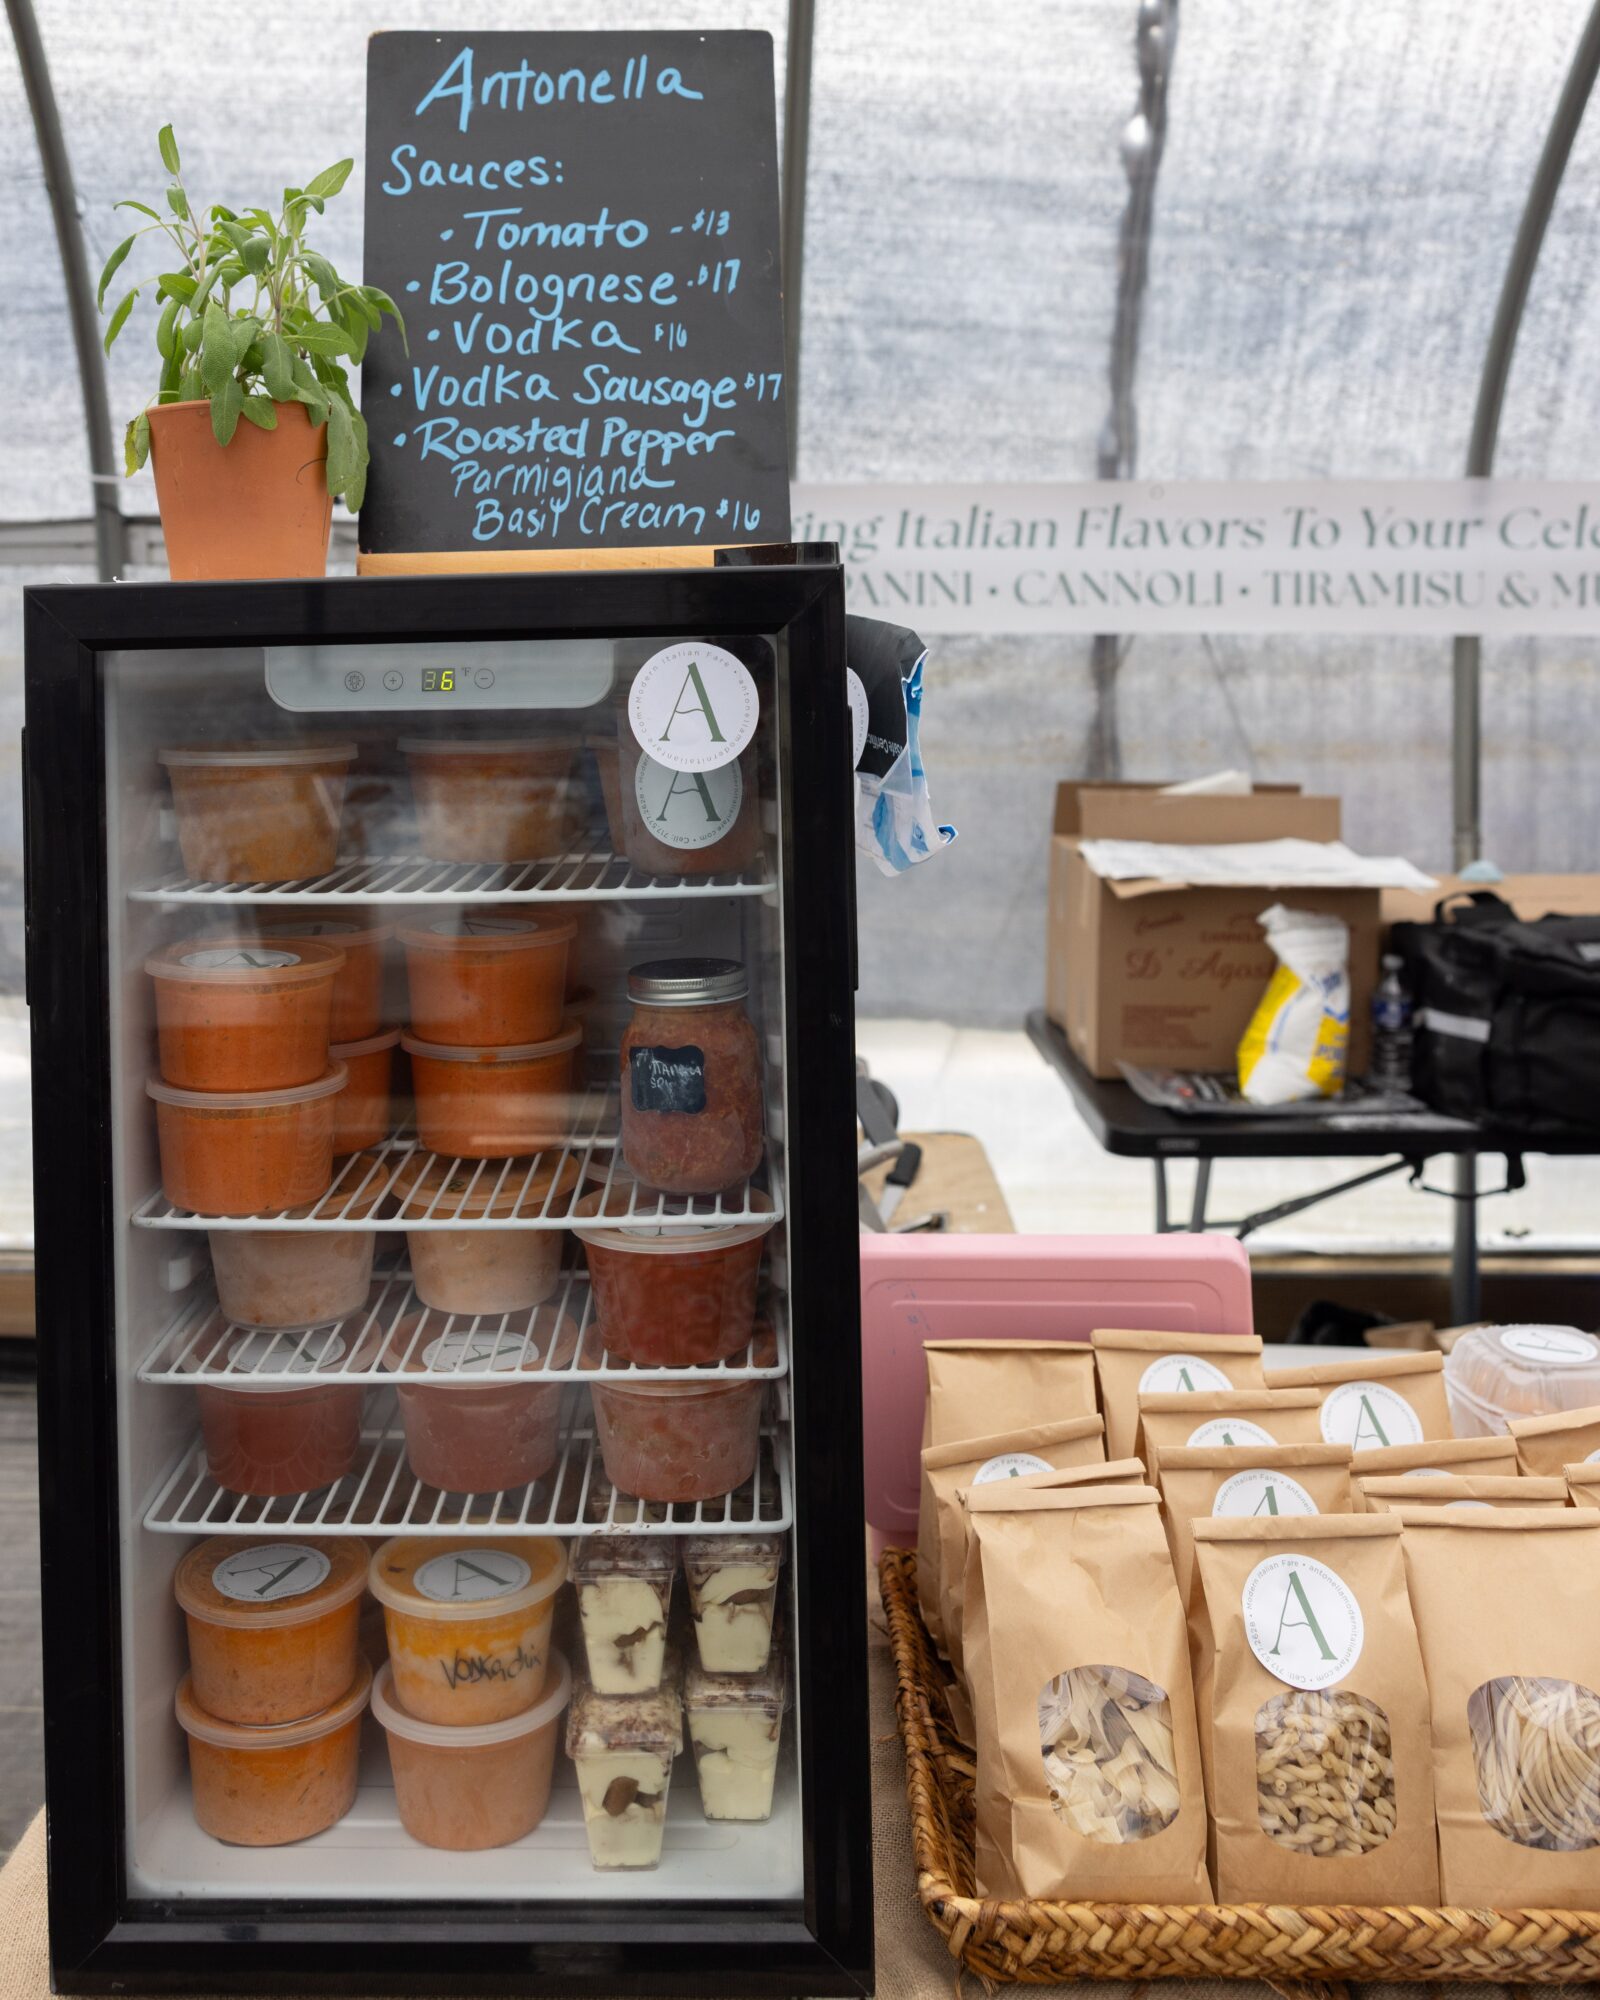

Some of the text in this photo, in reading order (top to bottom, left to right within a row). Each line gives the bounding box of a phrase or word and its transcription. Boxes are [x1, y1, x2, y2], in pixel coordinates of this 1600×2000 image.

[416, 48, 704, 132] Antonella
[383, 144, 564, 196] Sauces:
[463, 207, 649, 251] Tomato
[430, 259, 679, 321] Bolognese
[453, 312, 687, 355] Vodka $16
[413, 363, 783, 428] Vodka Sausage $17
[414, 416, 737, 467] Roasted Pepper
[450, 458, 675, 507] Parmigiana
[578, 500, 706, 535] Cream
[715, 498, 761, 532] $16
[896, 503, 1058, 549] Italian
[1074, 502, 1267, 550] Flavors
[1283, 506, 1342, 550] To
[1360, 507, 1485, 550] Your
[1013, 570, 1223, 608] CANNOLI
[1263, 570, 1486, 608] TIRAMISU
[1497, 570, 1539, 608] &
[659, 662, 727, 742] A
[1269, 1571, 1338, 1660] A
